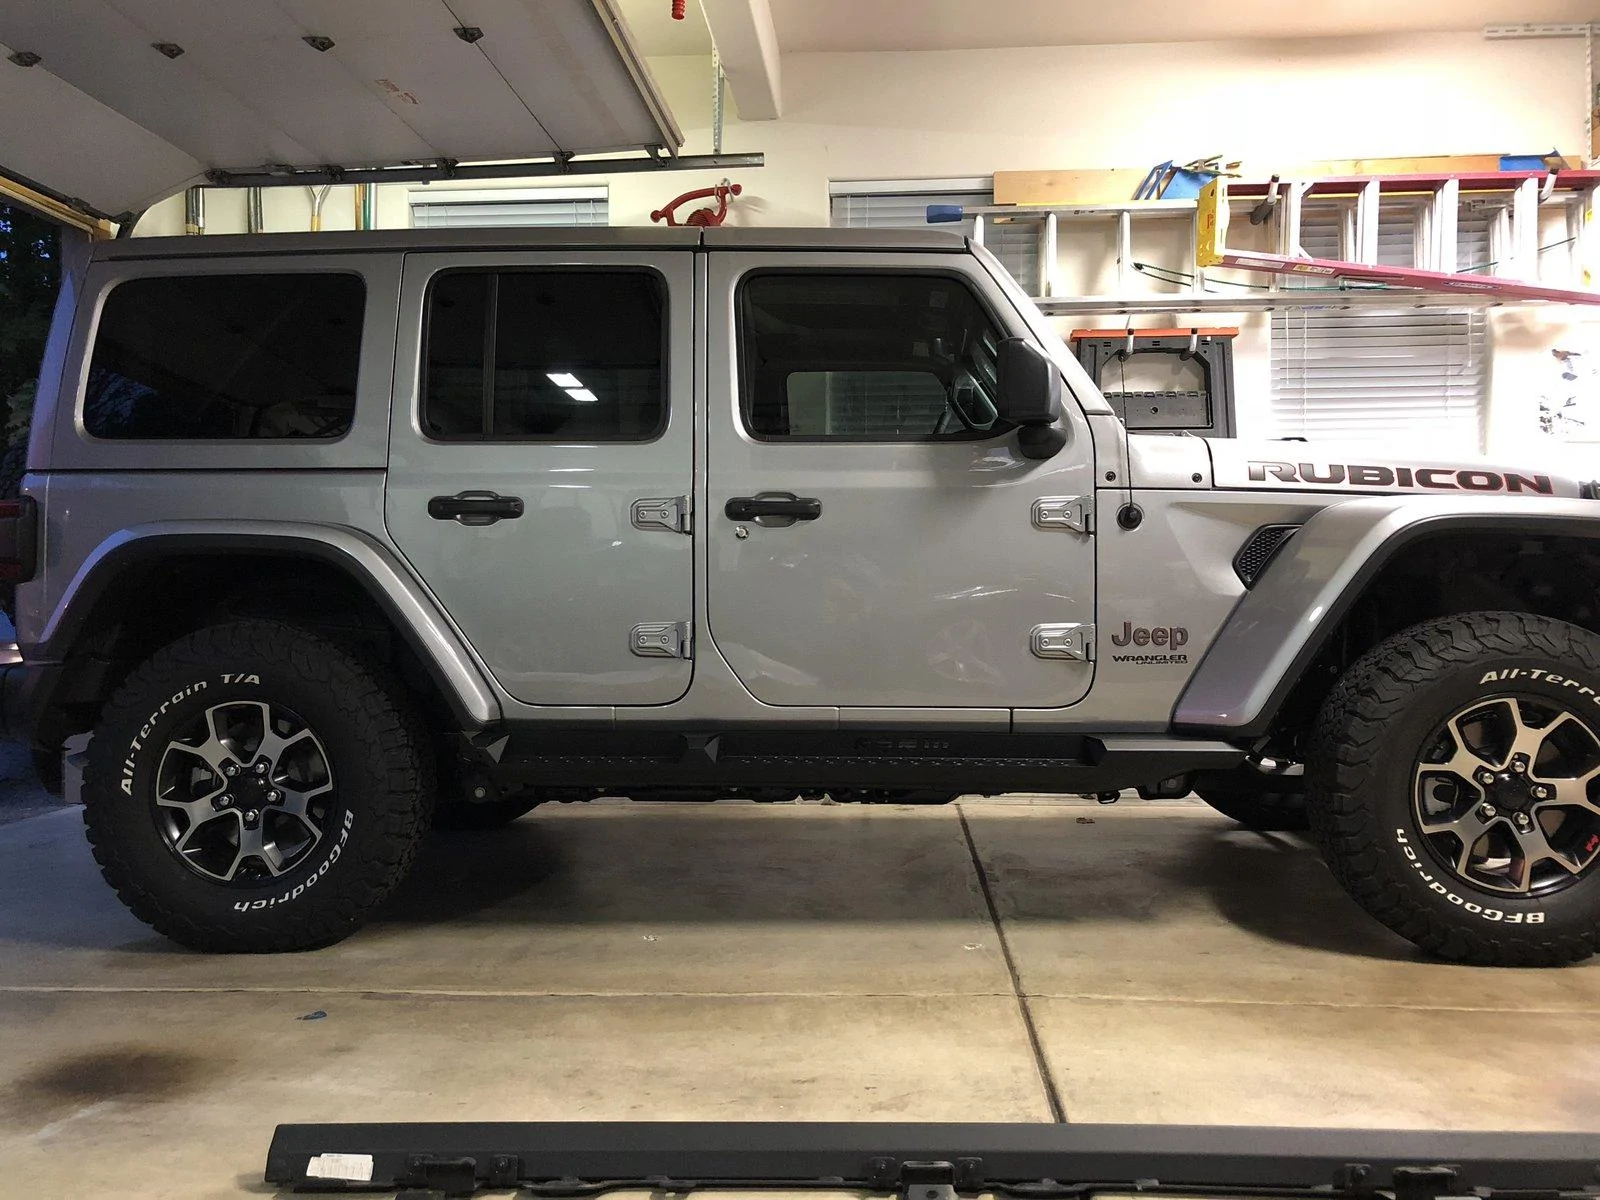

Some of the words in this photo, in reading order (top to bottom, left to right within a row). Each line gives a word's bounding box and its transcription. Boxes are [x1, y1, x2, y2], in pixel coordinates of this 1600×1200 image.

[1247, 460, 1554, 495] RUBICON
[1111, 621, 1189, 650] Jeep
[1112, 654, 1188, 662] WRANGLER
[121, 681, 208, 796] All-Terrain
[220, 673, 261, 685] T/A
[233, 809, 354, 912] BFGoodrich
[1396, 828, 1546, 924] BFGoodrich
